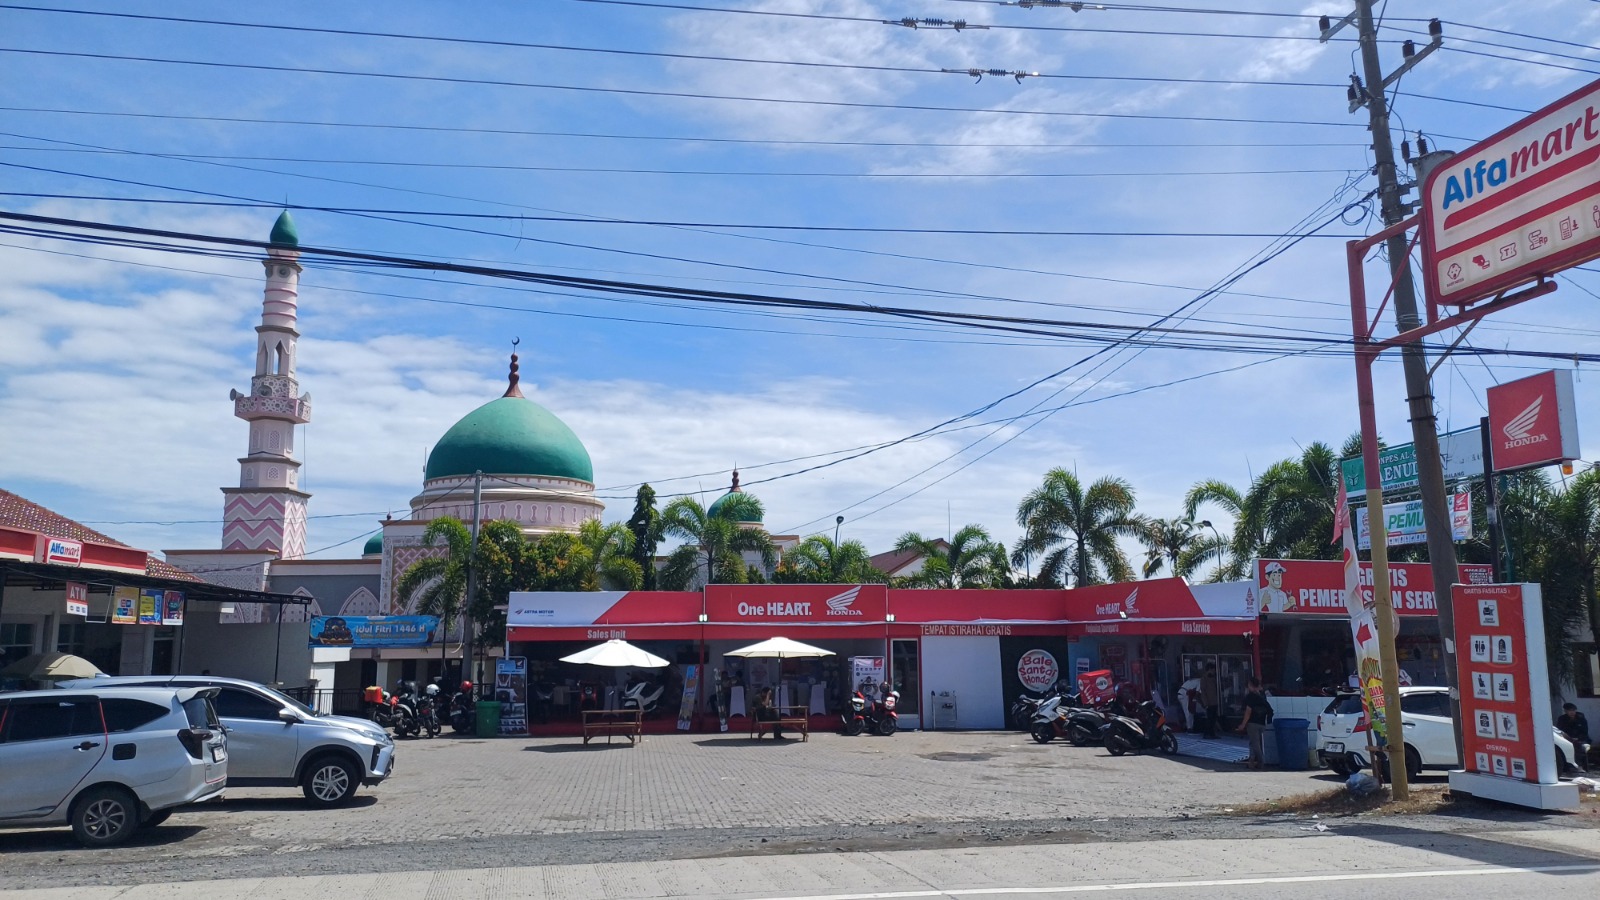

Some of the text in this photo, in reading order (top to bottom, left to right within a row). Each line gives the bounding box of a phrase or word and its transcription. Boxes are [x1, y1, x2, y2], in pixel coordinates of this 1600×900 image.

[1442, 106, 1600, 210] Alfamart
[1504, 433, 1549, 449] HONDA
[1388, 511, 1425, 530] PEMU
[50, 542, 80, 557] Alfamart
[1359, 567, 1408, 587] GRIS
[70, 585, 86, 601] ATM
[737, 602, 812, 616] One HEART.
[375, 624, 392, 633] Fitri
[395, 624, 416, 633] 1446
[419, 624, 425, 633] H
[587, 629, 626, 639] Sales Unit
[920, 625, 1011, 635] TEMPAT ISTIRAHAT GRATIS
[1181, 622, 1211, 634] Area Service
[1021, 655, 1053, 666] Bale
[1018, 665, 1058, 678] Santai
[1022, 675, 1051, 685] Honda
[1485, 744, 1508, 753] DISKON
